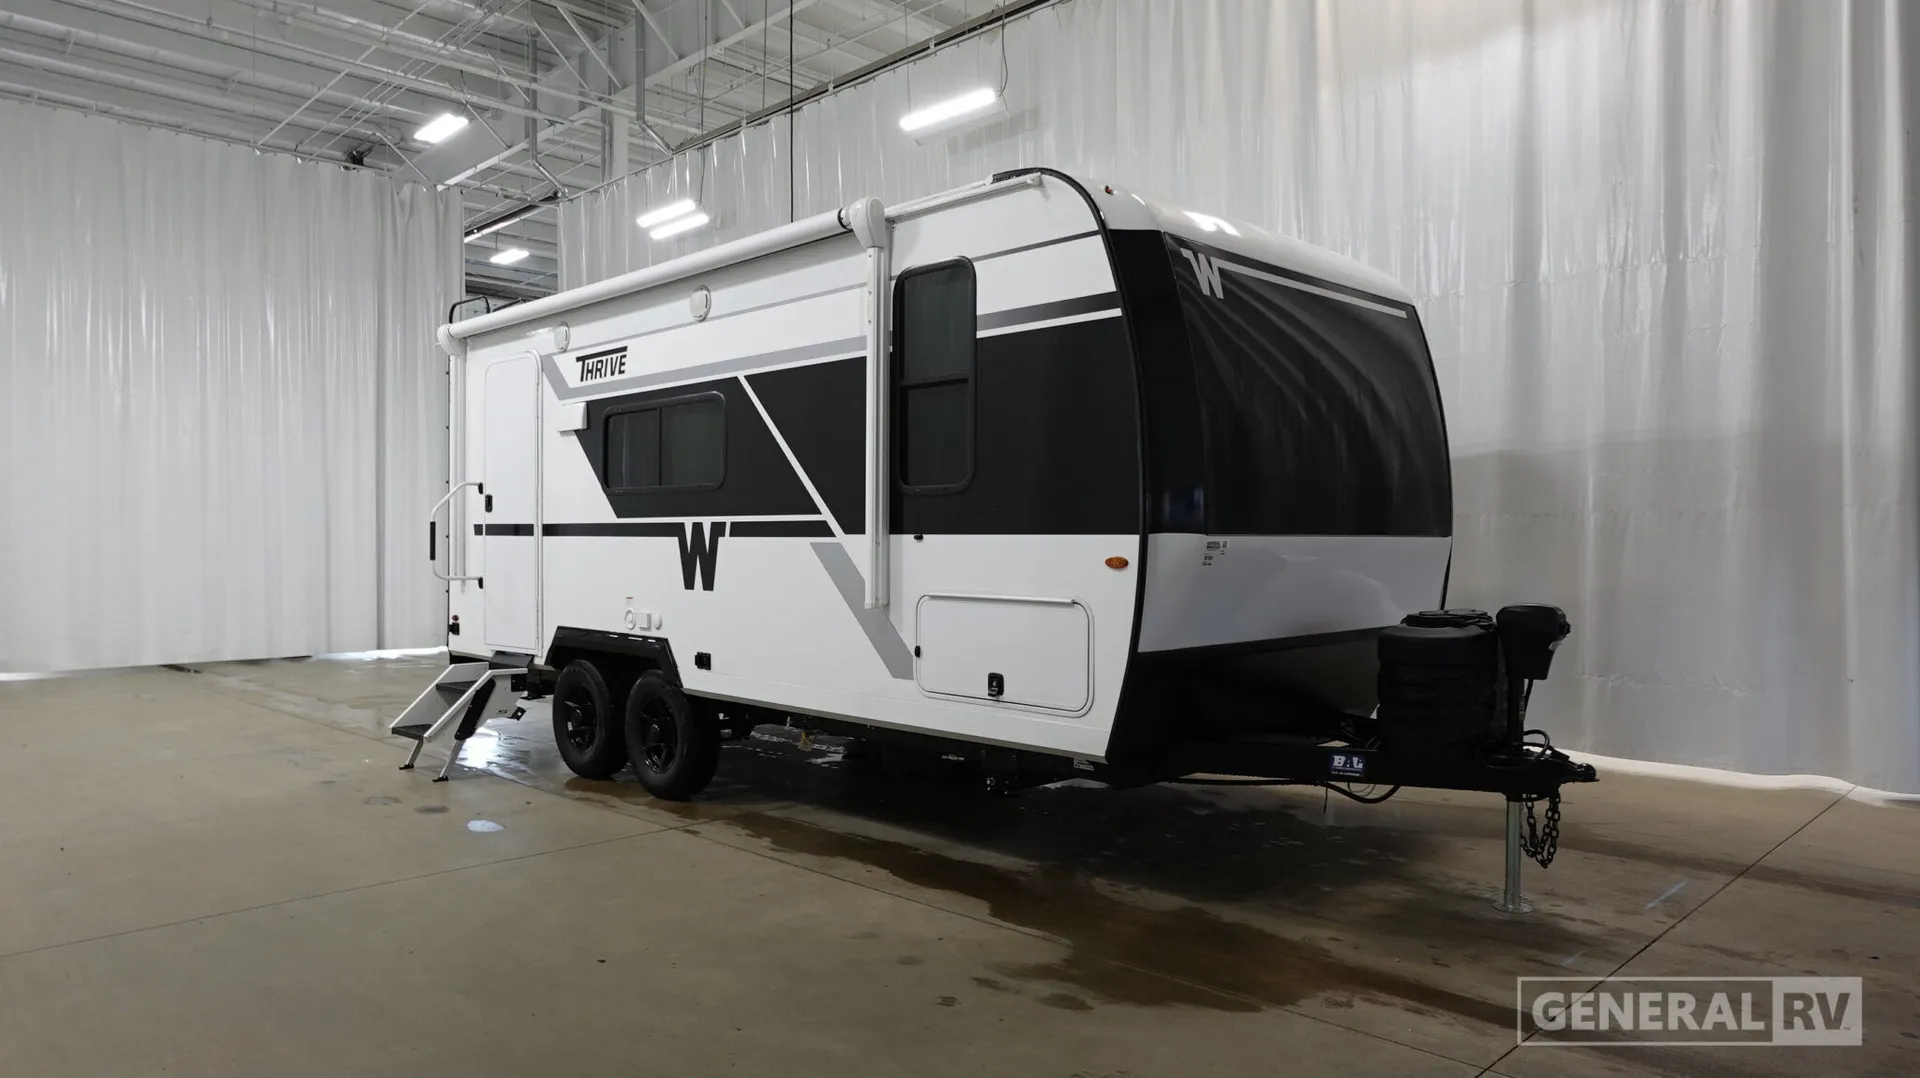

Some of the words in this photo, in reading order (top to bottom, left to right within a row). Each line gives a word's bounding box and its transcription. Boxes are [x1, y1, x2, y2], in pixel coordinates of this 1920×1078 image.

[1180, 247, 1224, 299] W
[576, 346, 627, 382] THRIVE
[673, 521, 726, 591] W
